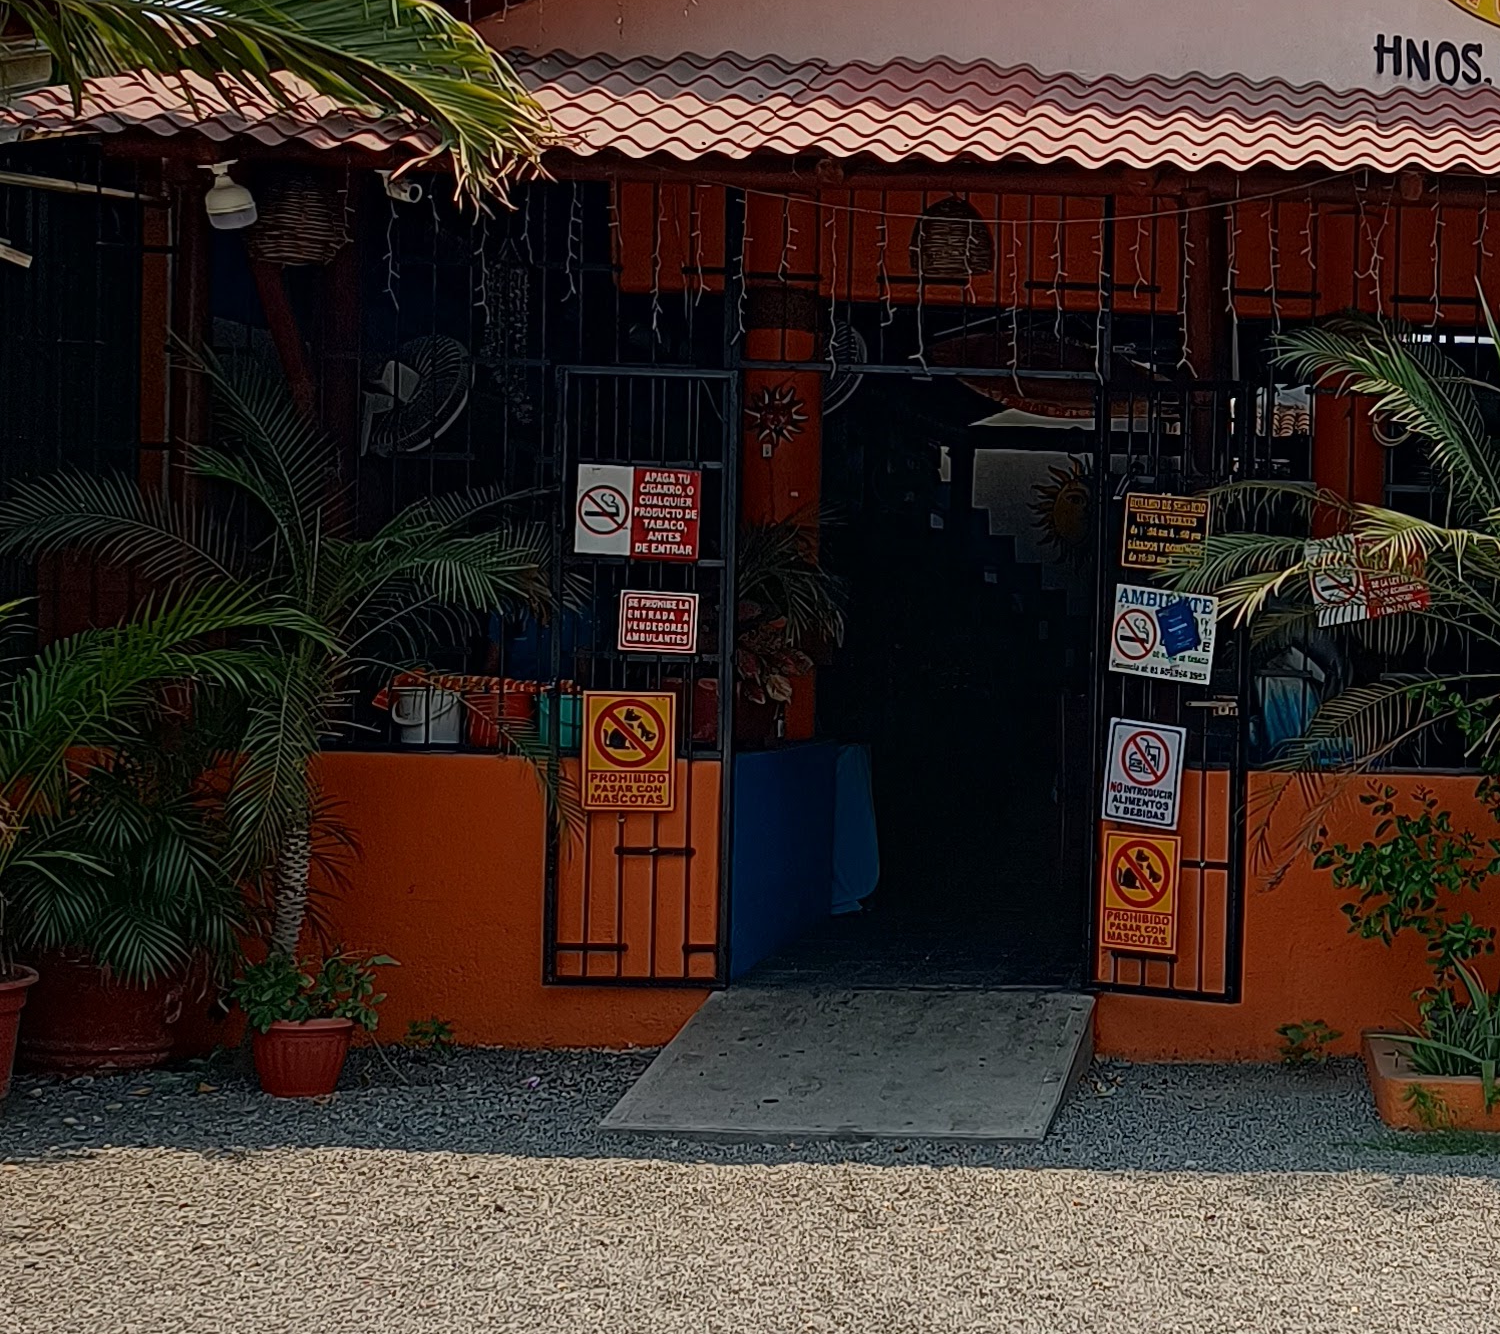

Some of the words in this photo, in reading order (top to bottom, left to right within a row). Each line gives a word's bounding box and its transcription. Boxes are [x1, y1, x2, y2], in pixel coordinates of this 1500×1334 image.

[1374, 34, 1492, 86] HNOS.
[645, 472, 675, 483] APAGA
[678, 474, 690, 485] TU
[640, 484, 685, 496] CIGARRO,
[687, 486, 694, 495] O
[639, 495, 692, 507] CUALQUIER
[634, 507, 683, 518] PRODUCTO
[685, 509, 697, 519] DE
[643, 519, 687, 533] TABACO,
[647, 532, 681, 542] ANTES
[635, 543, 648, 552] DE
[652, 544, 692, 555] ENTRAR
[679, 601, 689, 609] LA
[627, 610, 675, 620] ENTRADA
[683, 613, 689, 621] A
[627, 621, 688, 632] VENDEDORES
[626, 632, 687, 644] AMBULANTES
[590, 773, 666, 784] PROHIBIDO
[594, 784, 633, 793] PASAR
[636, 785, 662, 793] CON
[1110, 781, 1123, 793] NO
[1123, 785, 1172, 800] INTRODUCIR
[590, 793, 664, 804] MASCOTAS
[1112, 794, 1169, 811] ALIMENTOS
[1114, 805, 1120, 814] Y
[1123, 806, 1165, 821] BEBIDAS
[1107, 911, 1170, 925] PROHIBIDO
[1110, 922, 1141, 932] PASAR
[1144, 925, 1166, 935] CON
[1107, 931, 1167, 945] MASCOTAS
